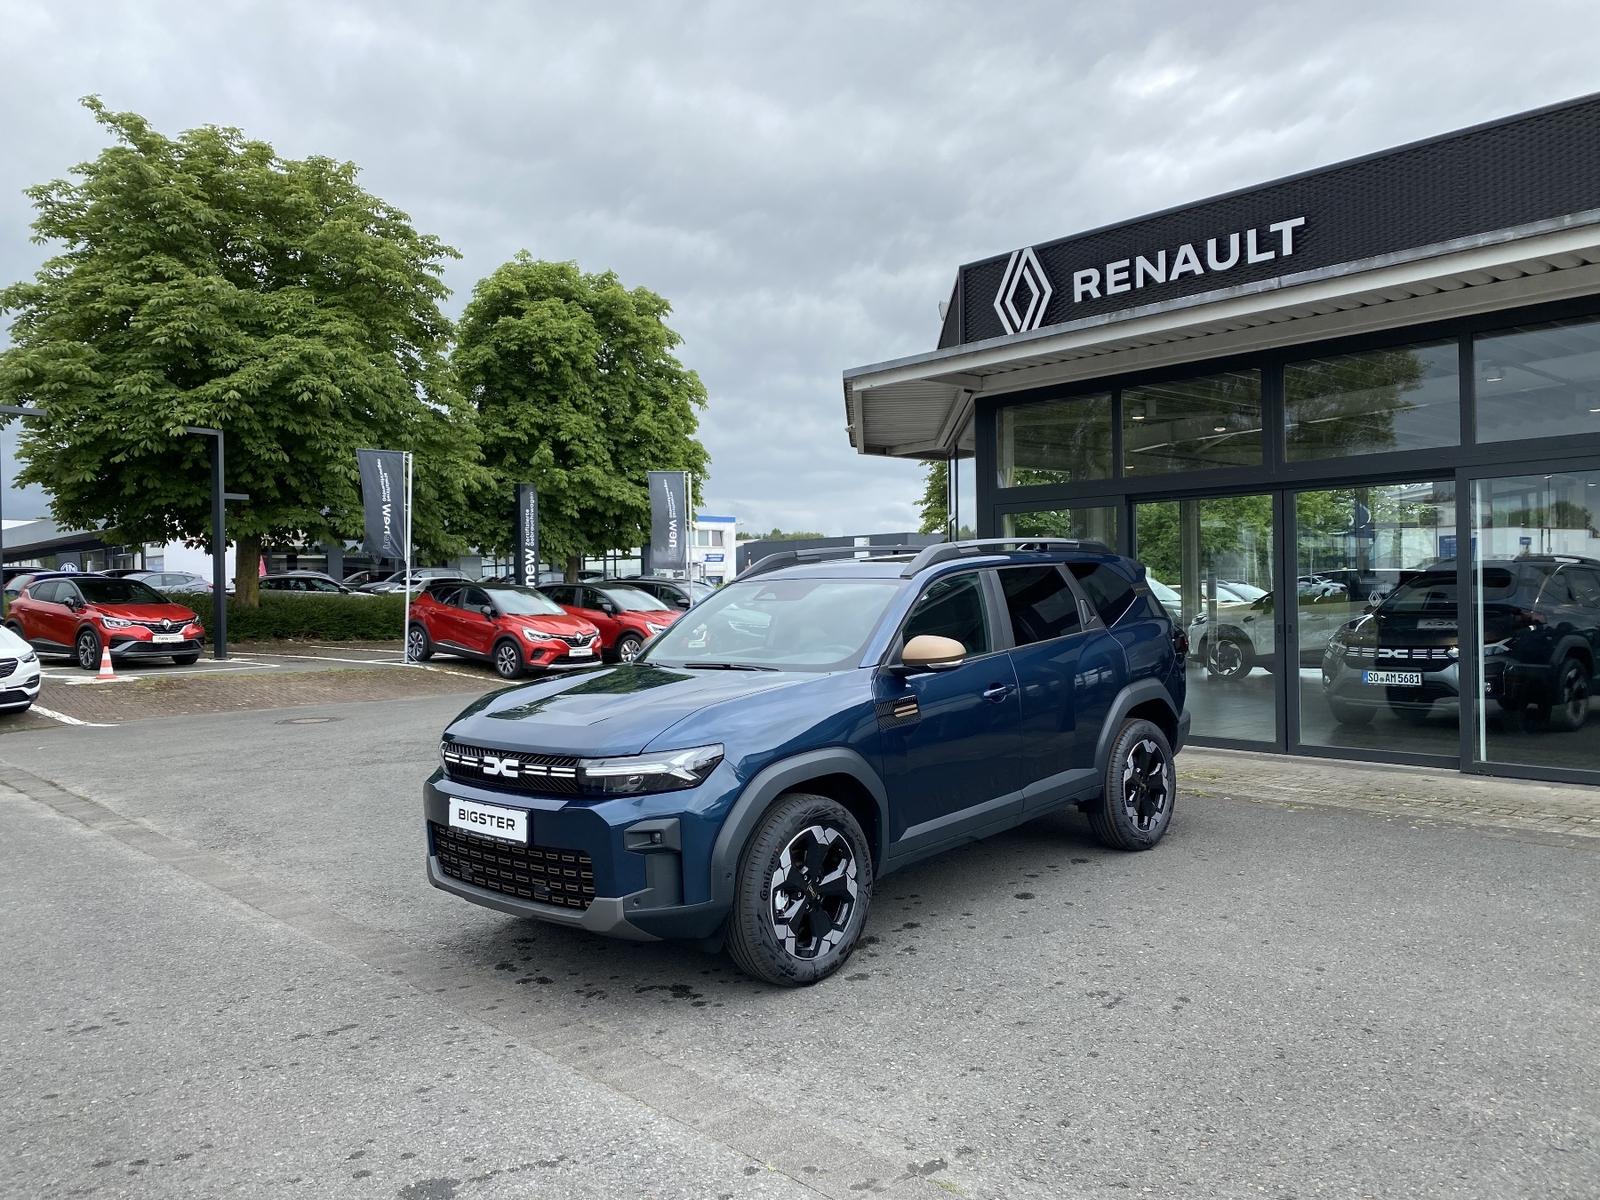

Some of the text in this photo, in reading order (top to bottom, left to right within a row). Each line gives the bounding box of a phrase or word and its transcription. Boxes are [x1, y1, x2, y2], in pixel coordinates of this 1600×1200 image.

[1073, 216, 1306, 303] RENAULT
[525, 548, 535, 589] new
[1368, 672, 1420, 684] SO AM 5681
[458, 808, 516, 831] BIGSTER
